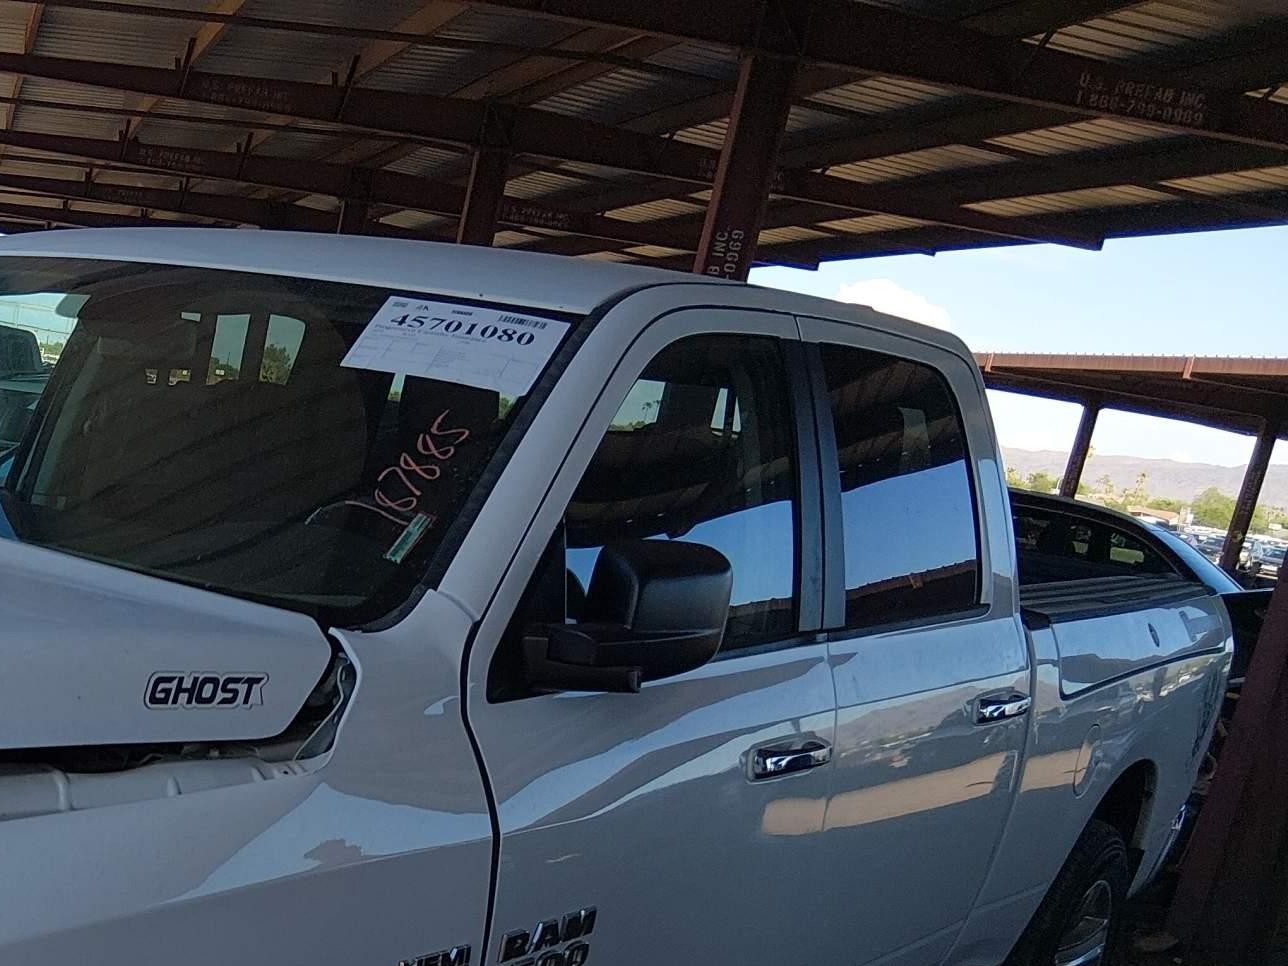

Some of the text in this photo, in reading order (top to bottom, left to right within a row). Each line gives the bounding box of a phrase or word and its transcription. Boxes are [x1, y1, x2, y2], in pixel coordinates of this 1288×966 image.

[389, 313, 535, 346] 45701080
[146, 674, 266, 706] GHOST
[496, 904, 598, 963] RAM
